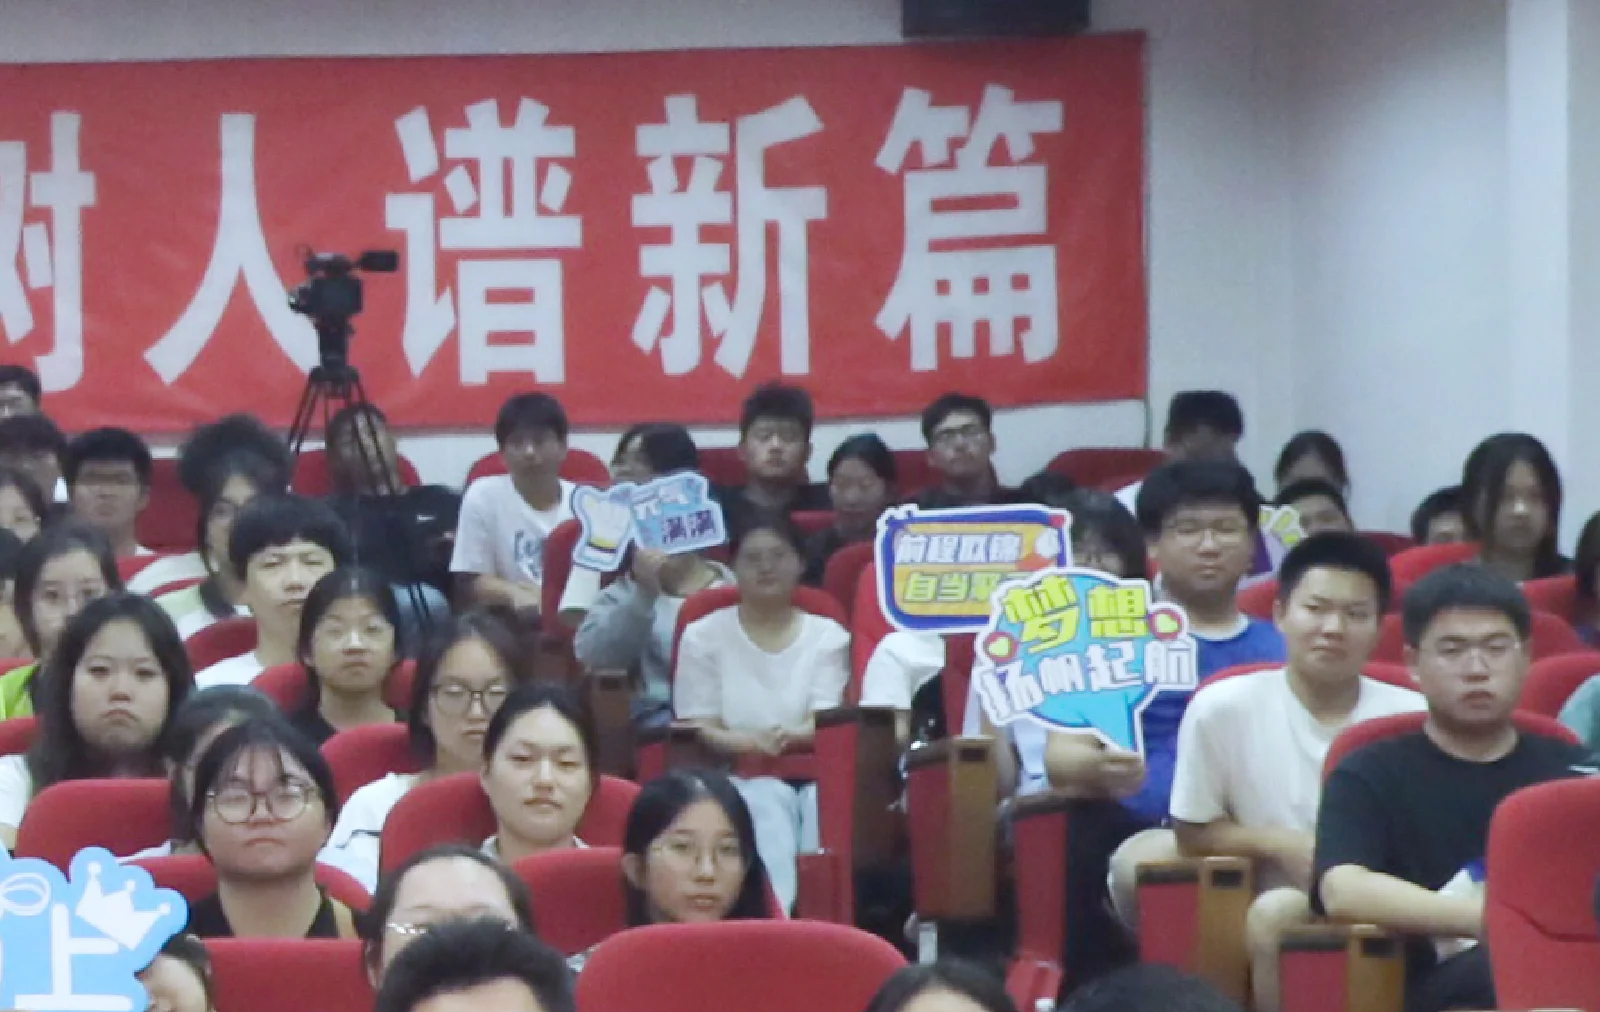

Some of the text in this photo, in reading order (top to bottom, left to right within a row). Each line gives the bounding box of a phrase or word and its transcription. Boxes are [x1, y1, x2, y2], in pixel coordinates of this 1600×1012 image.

[1004, 576, 1149, 654] 梦想
[981, 640, 1197, 719] 扬帆起航
